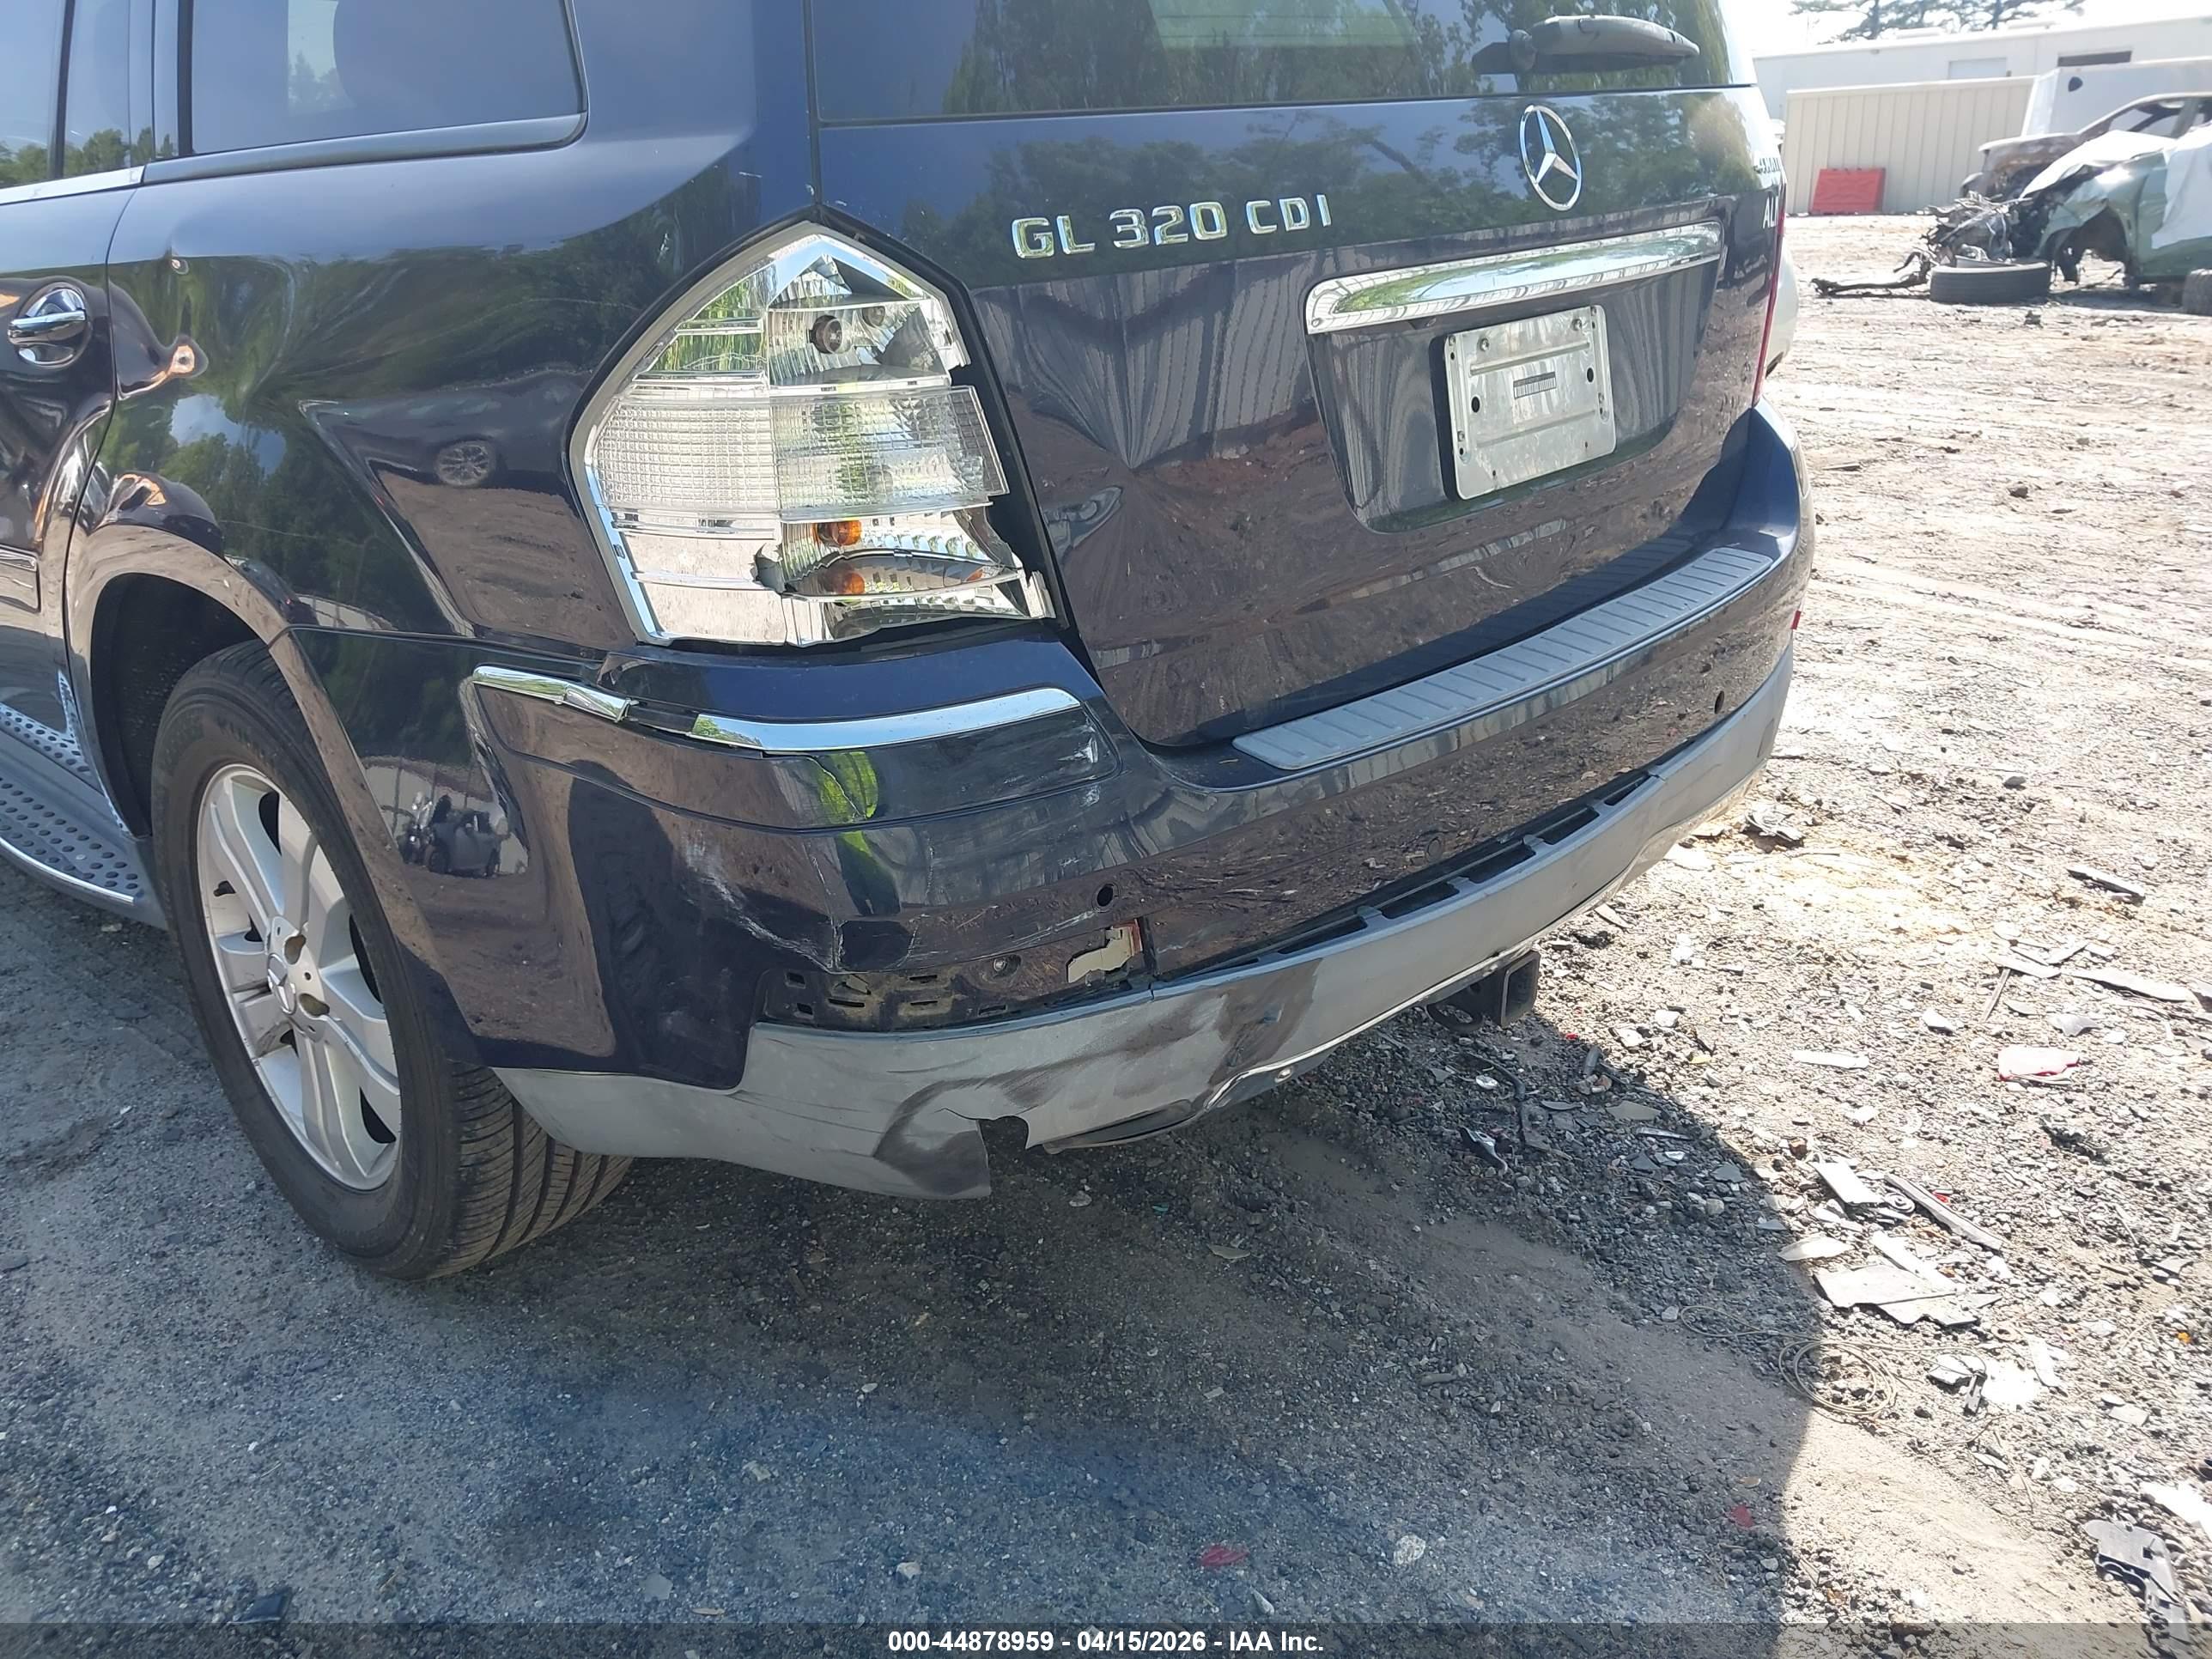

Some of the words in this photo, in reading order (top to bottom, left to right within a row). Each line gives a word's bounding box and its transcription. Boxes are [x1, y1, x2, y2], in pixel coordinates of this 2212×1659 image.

[1012, 215, 1096, 258] GL
[1109, 201, 1229, 248] 320
[1245, 194, 1332, 235] CDI
